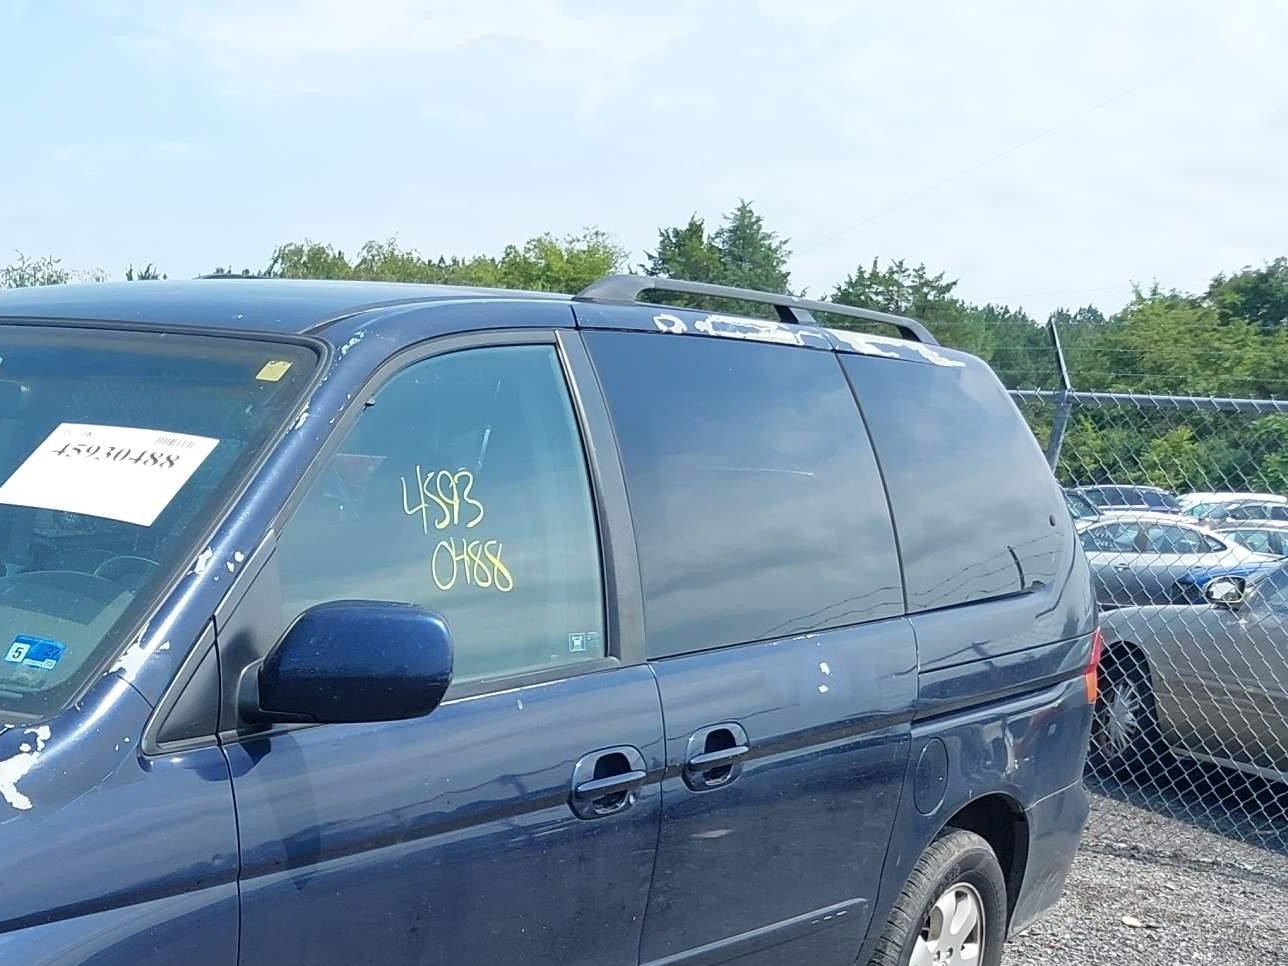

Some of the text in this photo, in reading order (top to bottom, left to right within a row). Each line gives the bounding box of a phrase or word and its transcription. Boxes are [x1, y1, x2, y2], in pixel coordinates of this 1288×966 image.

[52, 442, 180, 469] 45930488
[400, 465, 484, 534] 4593
[432, 537, 513, 592] 0488
[12, 647, 24, 659] 5
